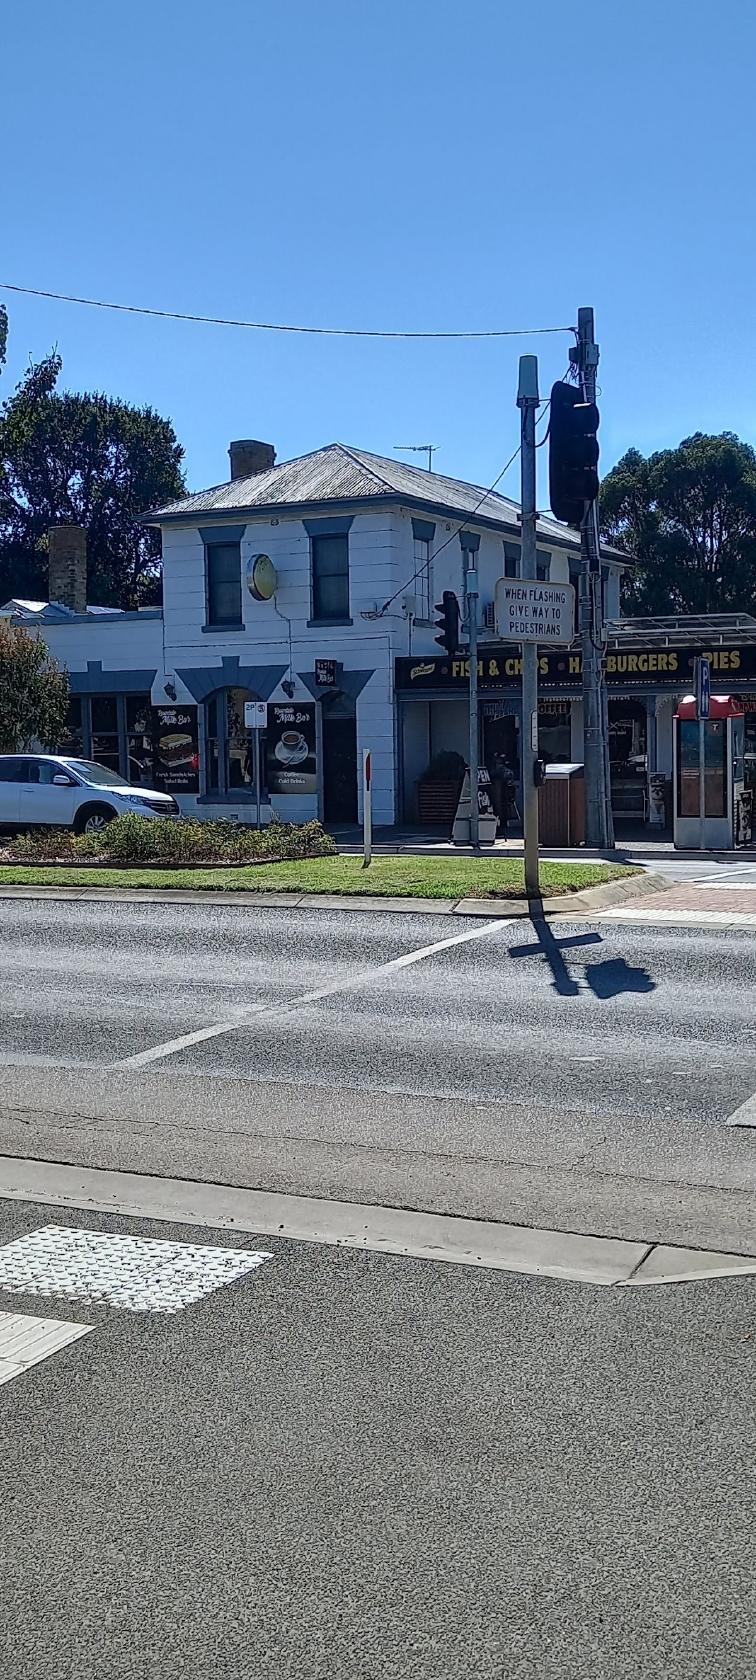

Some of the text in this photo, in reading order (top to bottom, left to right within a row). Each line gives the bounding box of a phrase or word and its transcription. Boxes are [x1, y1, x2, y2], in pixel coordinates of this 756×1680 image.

[504, 588, 566, 604] WHEN FLASHING
[509, 605, 561, 619] GIVE WAY TO
[509, 621, 560, 636] PEDESTRIANS
[488, 659, 500, 677] &
[505, 657, 549, 676] CHS
[568, 652, 679, 674] HBURGERS
[702, 666, 709, 686] P
[246, 703, 255, 711] 2P
[538, 702, 567, 716] OFFEE
[177, 714, 191, 725] Bar
[295, 712, 311, 724] Bar
